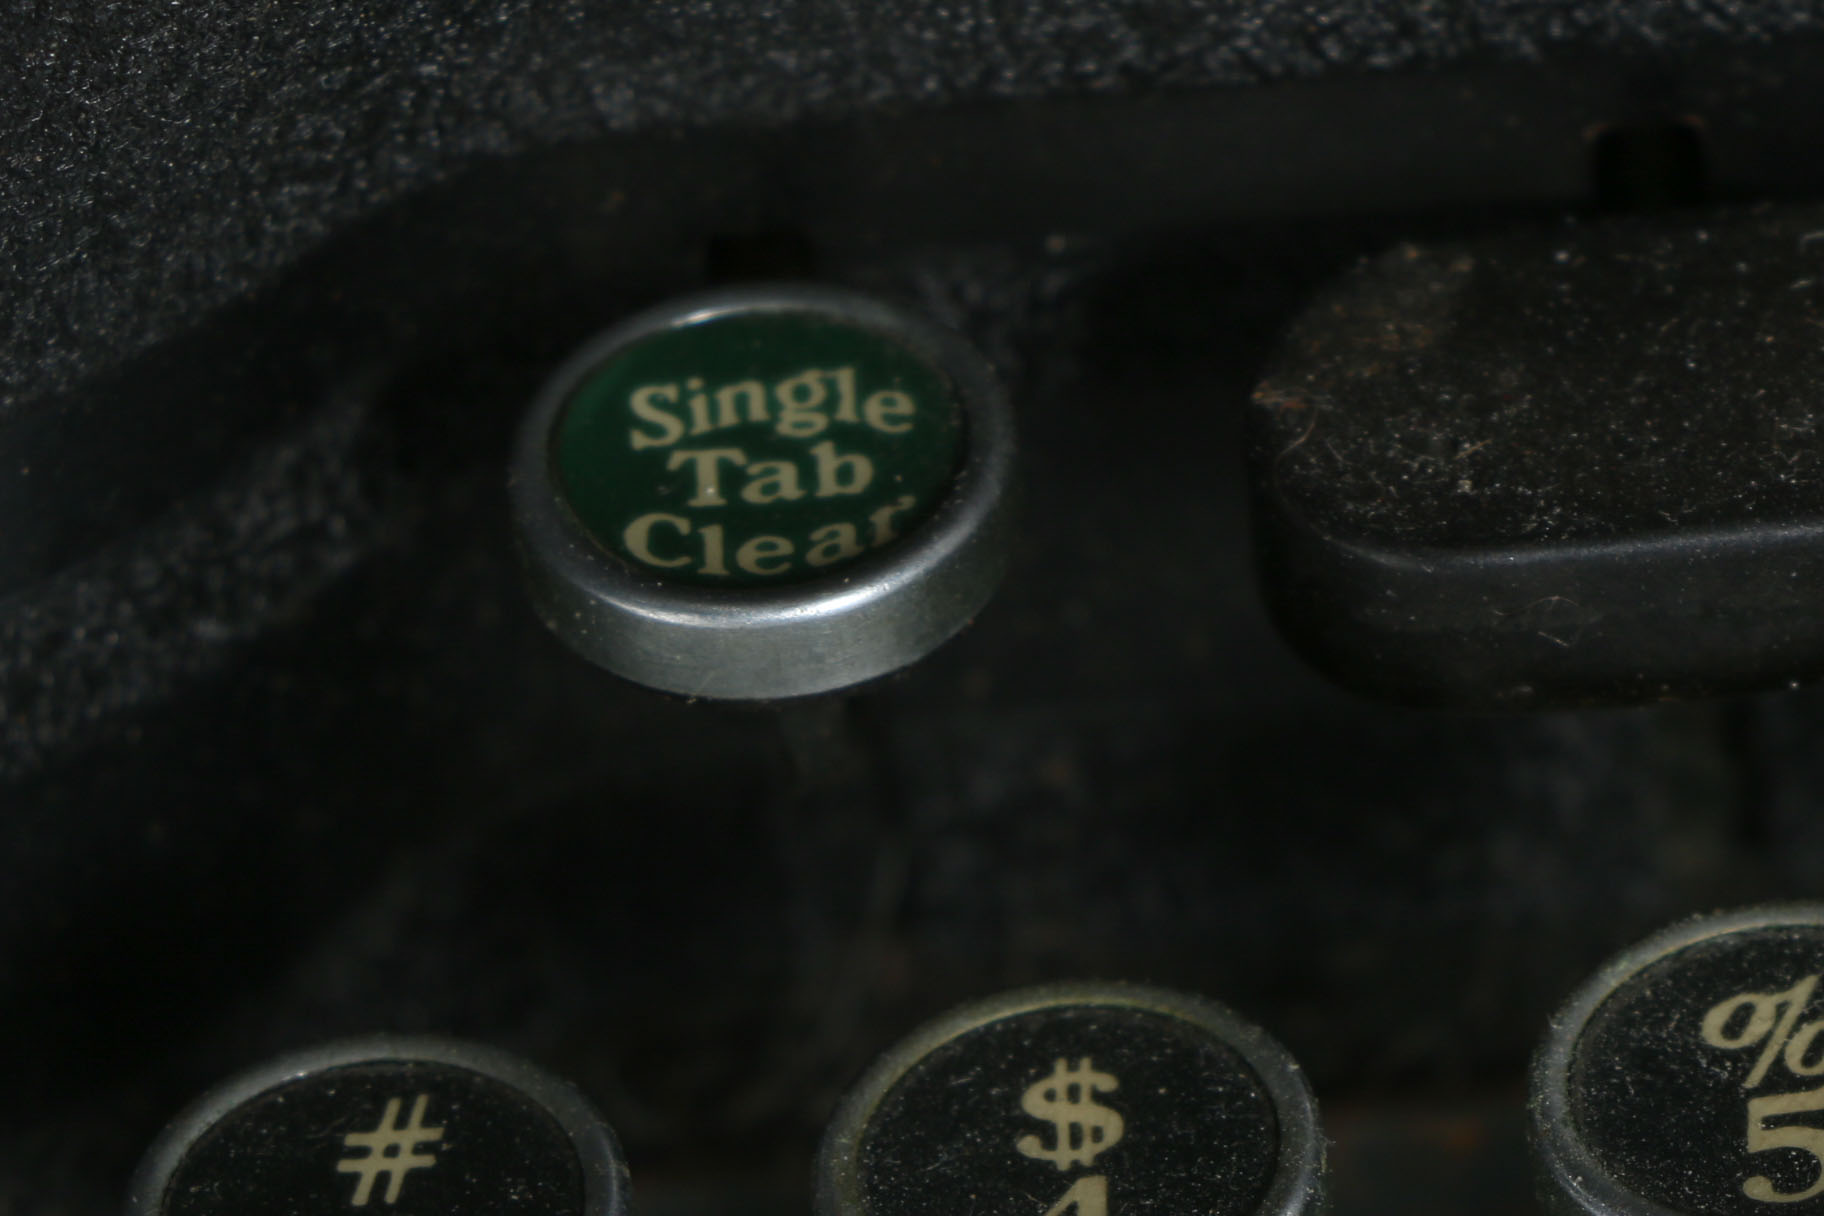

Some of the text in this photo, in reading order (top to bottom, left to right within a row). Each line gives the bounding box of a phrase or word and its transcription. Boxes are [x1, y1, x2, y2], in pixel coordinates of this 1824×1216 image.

[628, 366, 916, 451] Single
[667, 440, 874, 508] Tab
[623, 495, 916, 576] Clear
[336, 1094, 444, 1207] #
[1016, 1057, 1124, 1172] $
